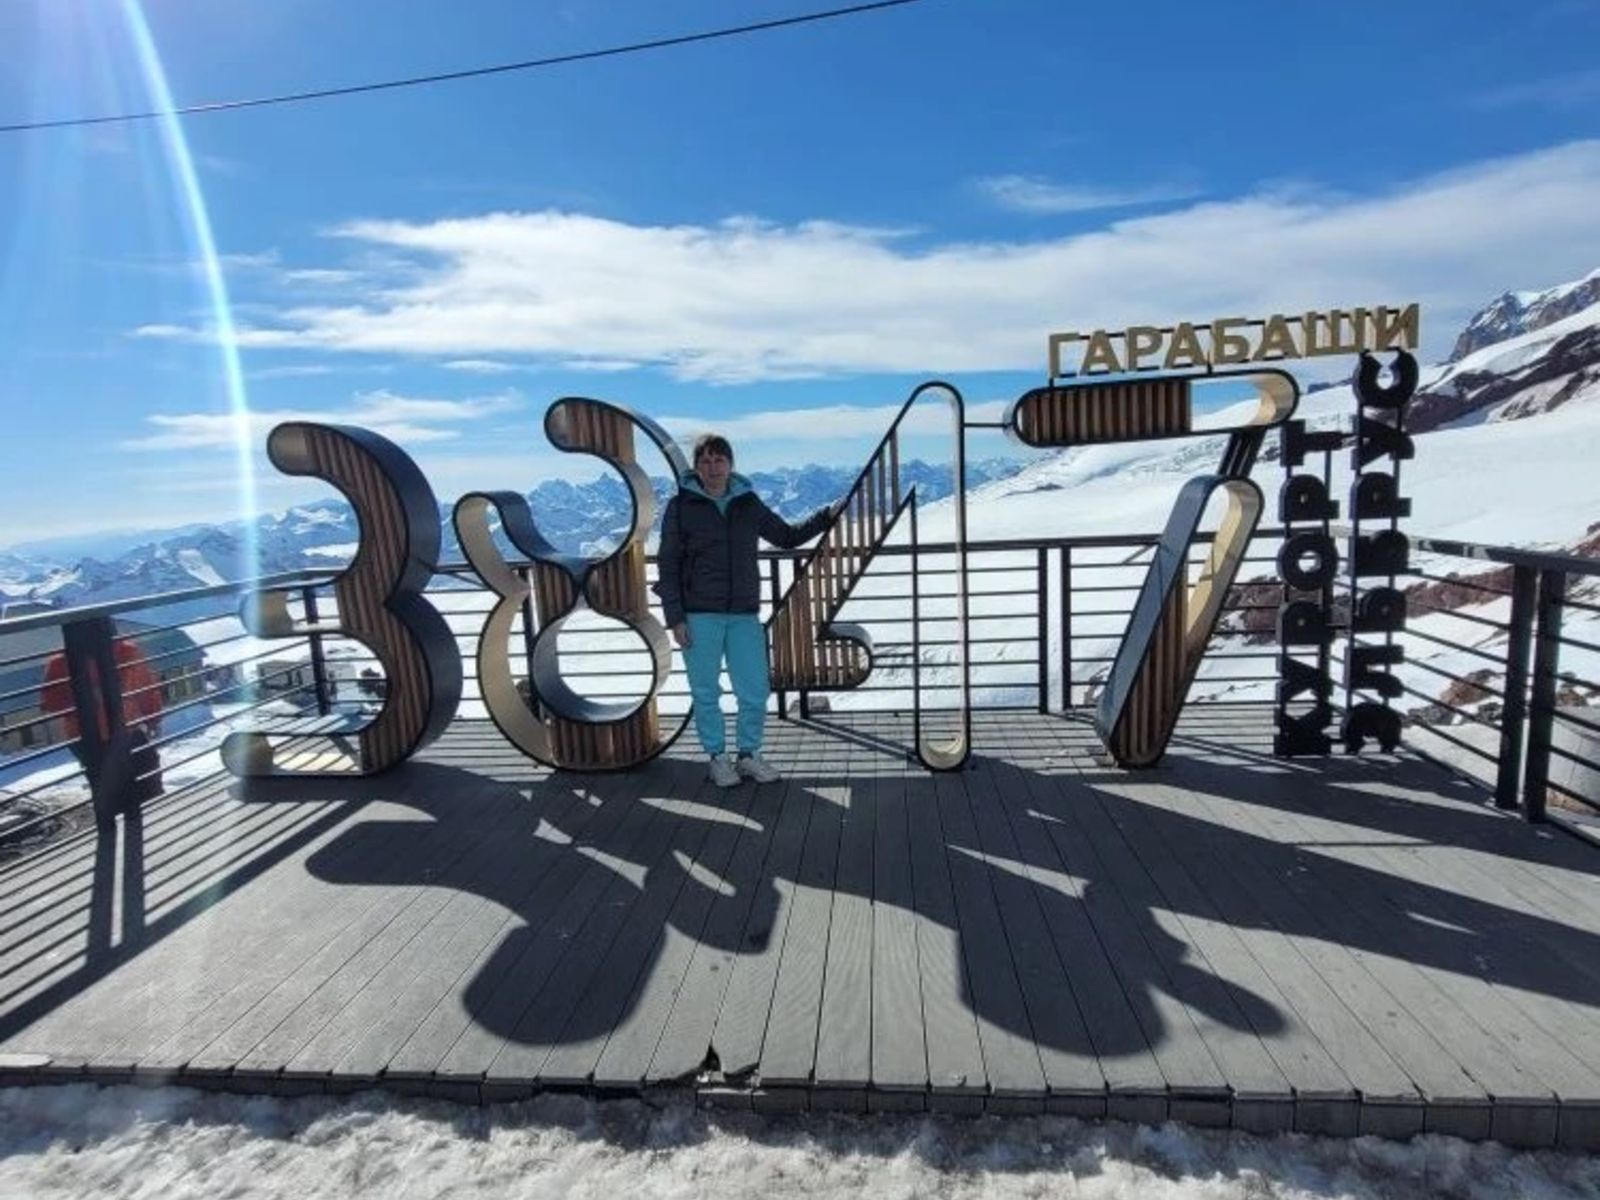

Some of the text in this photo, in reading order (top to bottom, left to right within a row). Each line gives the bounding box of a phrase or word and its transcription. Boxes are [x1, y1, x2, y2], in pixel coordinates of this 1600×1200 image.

[1048, 303, 1420, 377] ГАРАБАШИ
[221, 369, 1300, 777] 3847
[1274, 418, 1342, 757] КУРОРТ
[1342, 348, 1420, 755] ЭЛЬБРУС
